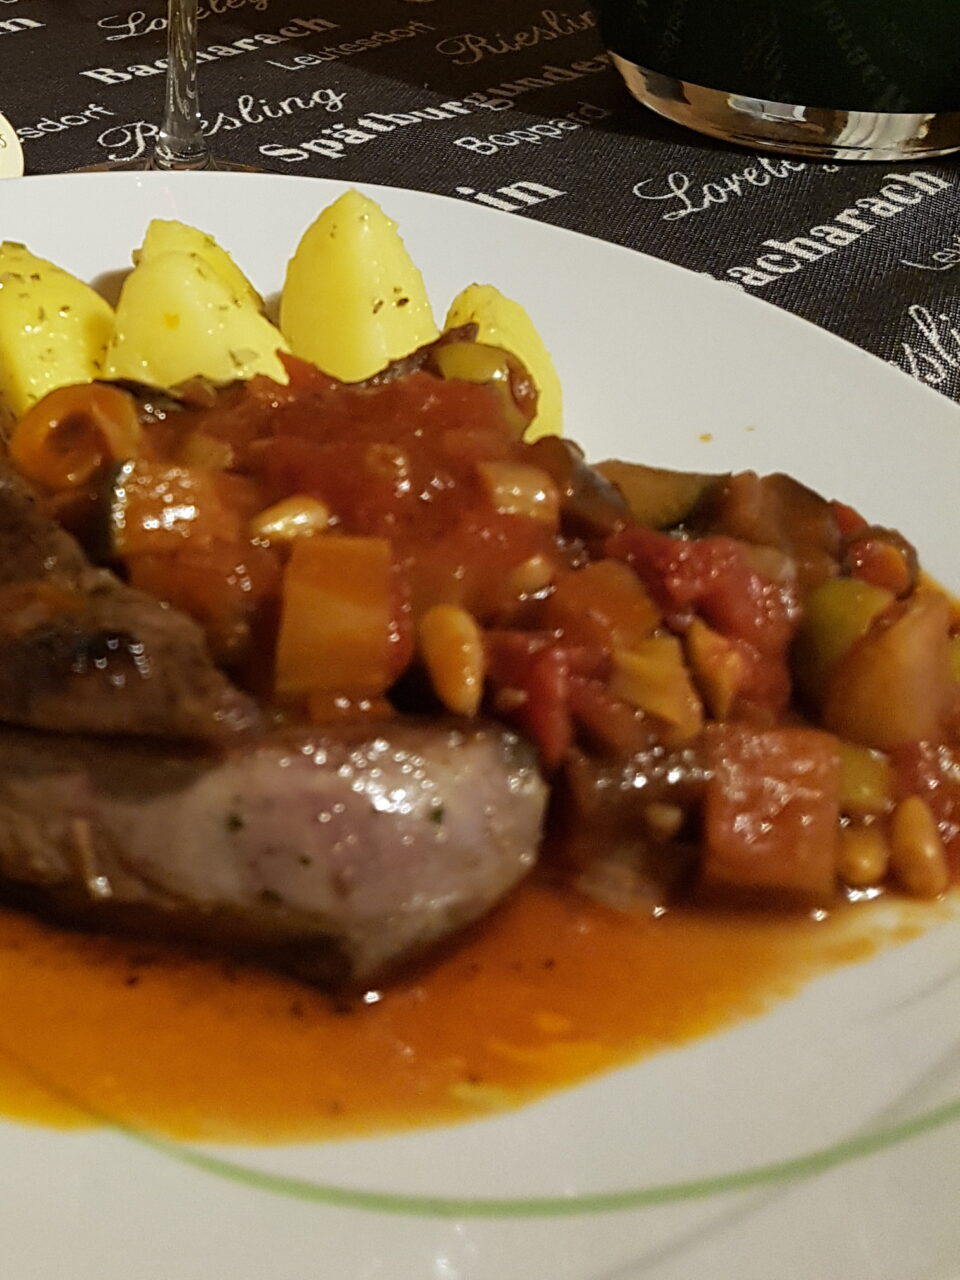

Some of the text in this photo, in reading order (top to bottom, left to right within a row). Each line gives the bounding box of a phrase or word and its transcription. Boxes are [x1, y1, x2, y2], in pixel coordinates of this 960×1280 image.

[266, 21, 437, 70] Leutesdorf
[16, 103, 115, 142] sdorf
[453, 101, 609, 156] Boppard
[727, 171, 954, 287] acharach
